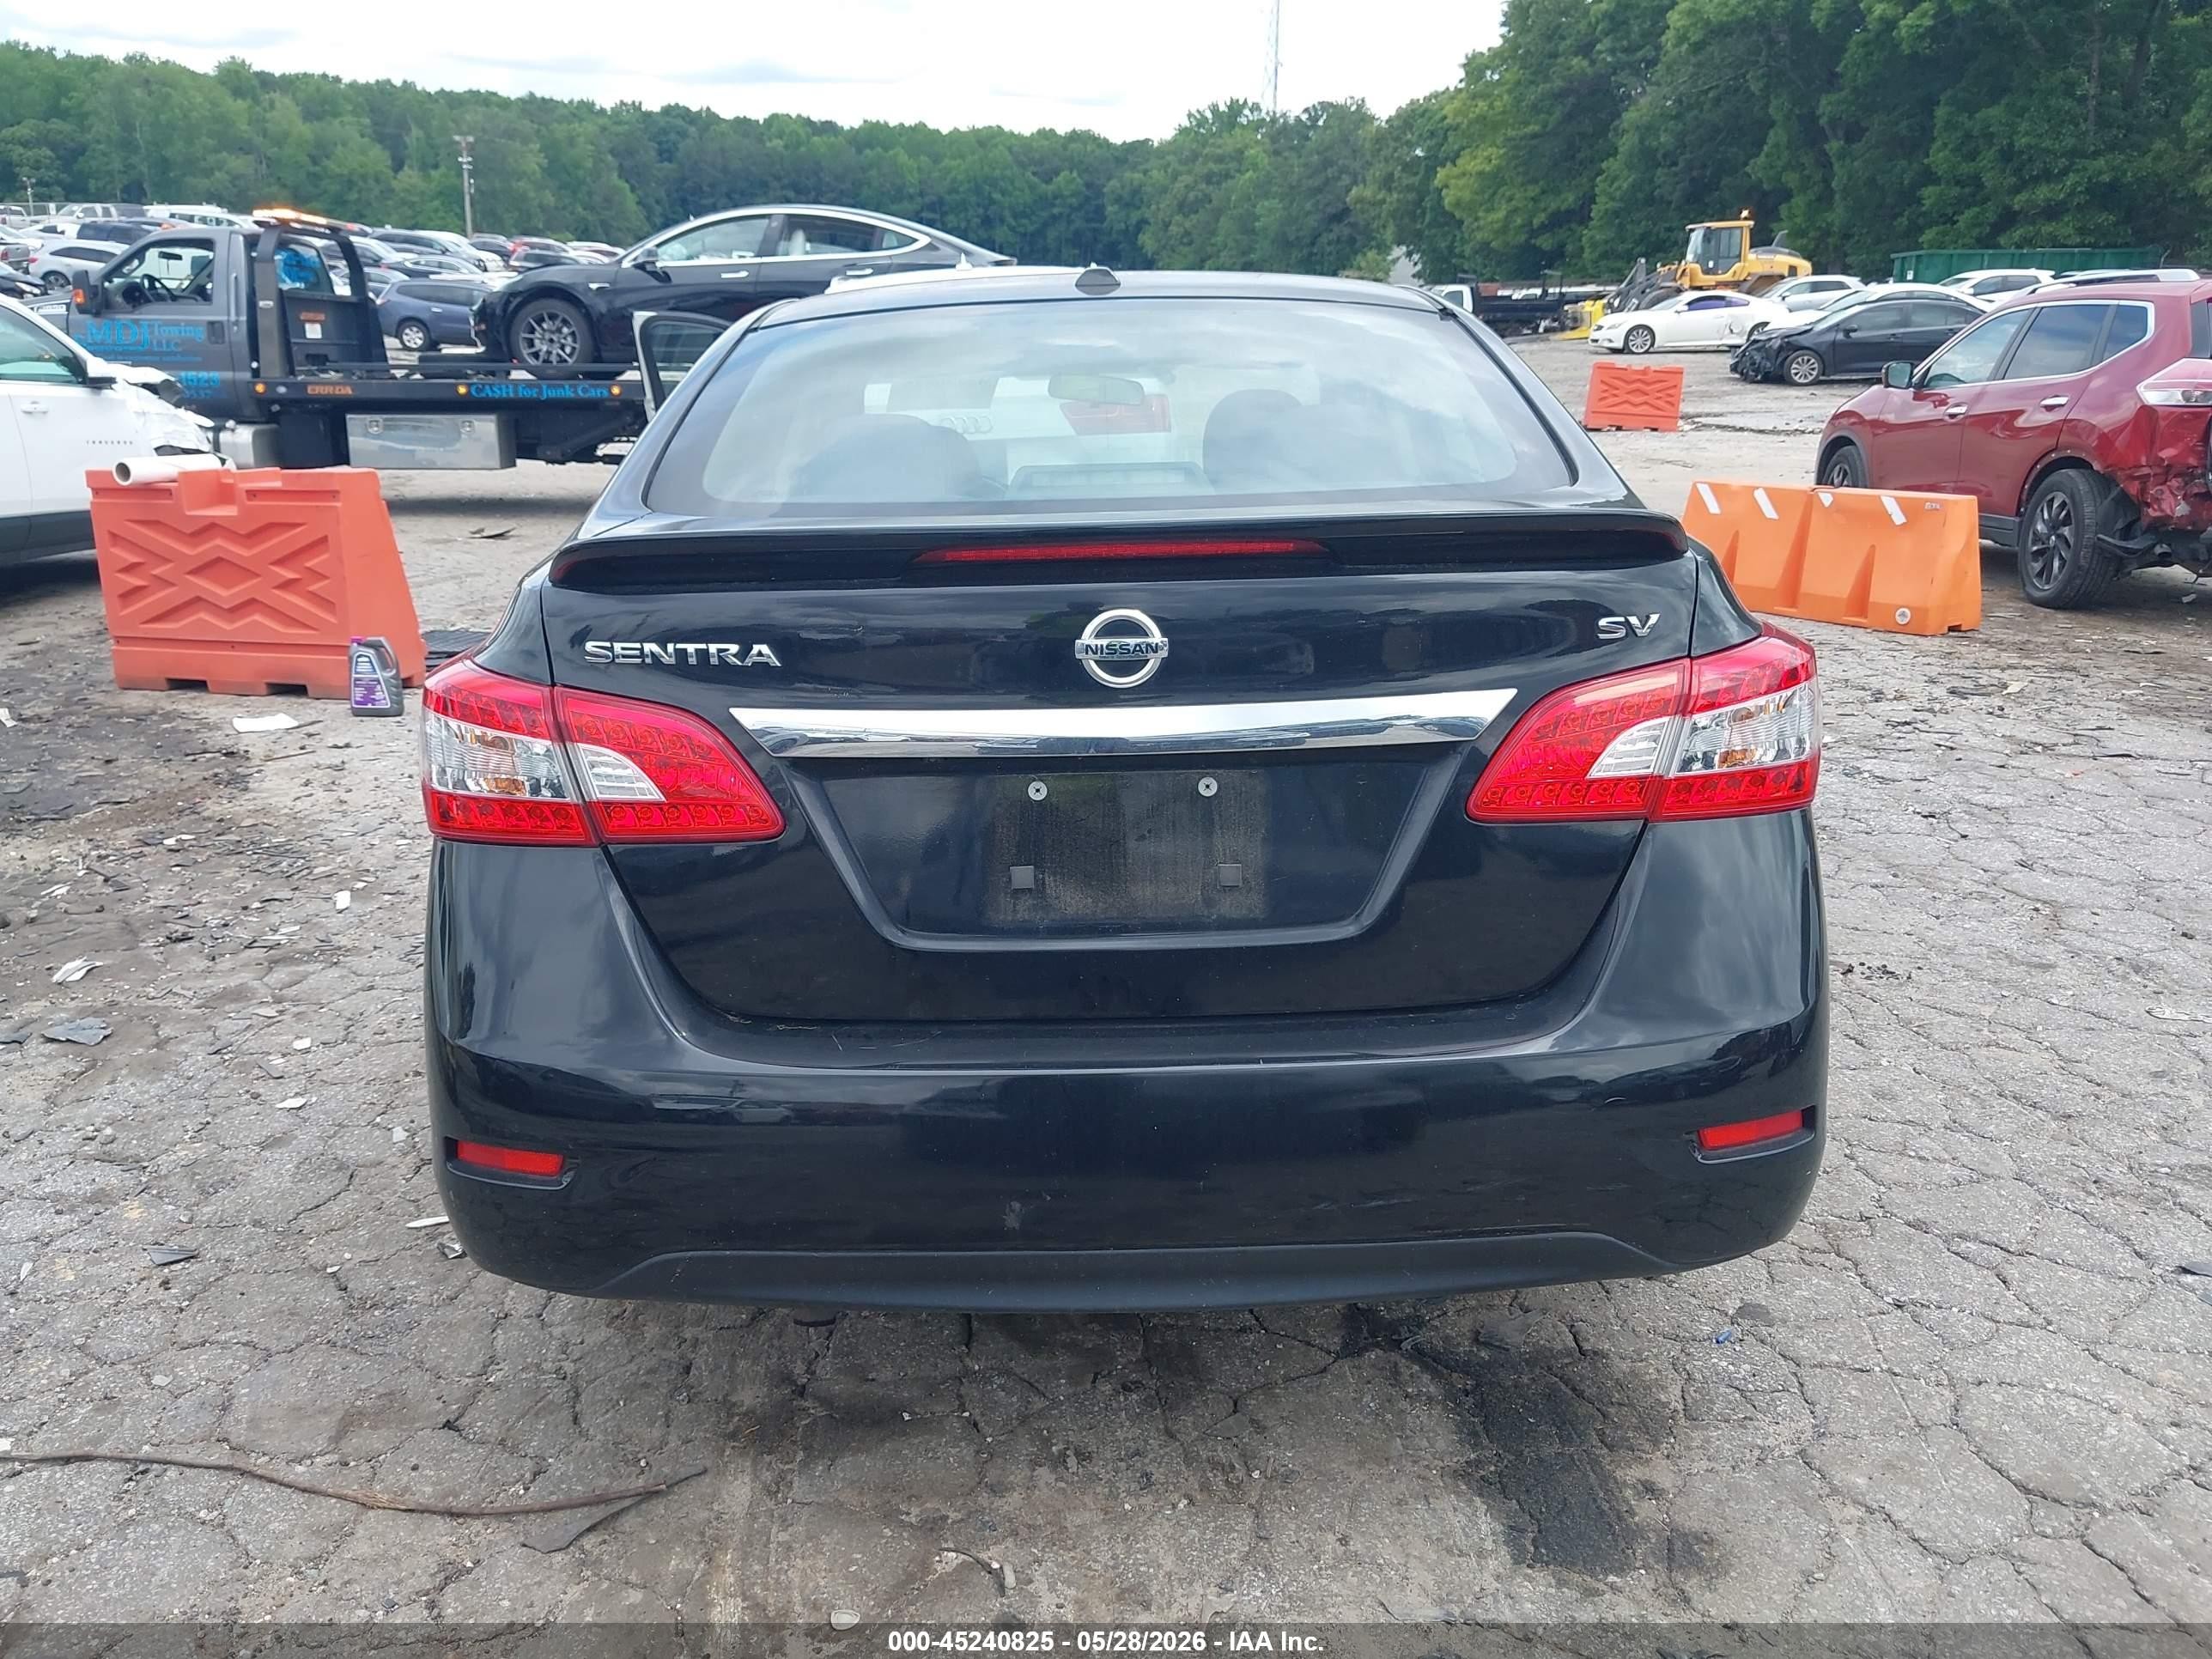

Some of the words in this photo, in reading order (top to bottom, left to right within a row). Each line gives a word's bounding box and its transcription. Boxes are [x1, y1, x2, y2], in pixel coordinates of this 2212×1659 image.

[471, 384, 513, 398] CASH
[519, 384, 538, 398] for
[539, 385, 574, 400] Junk
[576, 384, 610, 398] Cars
[1596, 612, 1662, 641] SV
[583, 640, 783, 667] SENTRA
[1084, 641, 1159, 656] NISSAN
